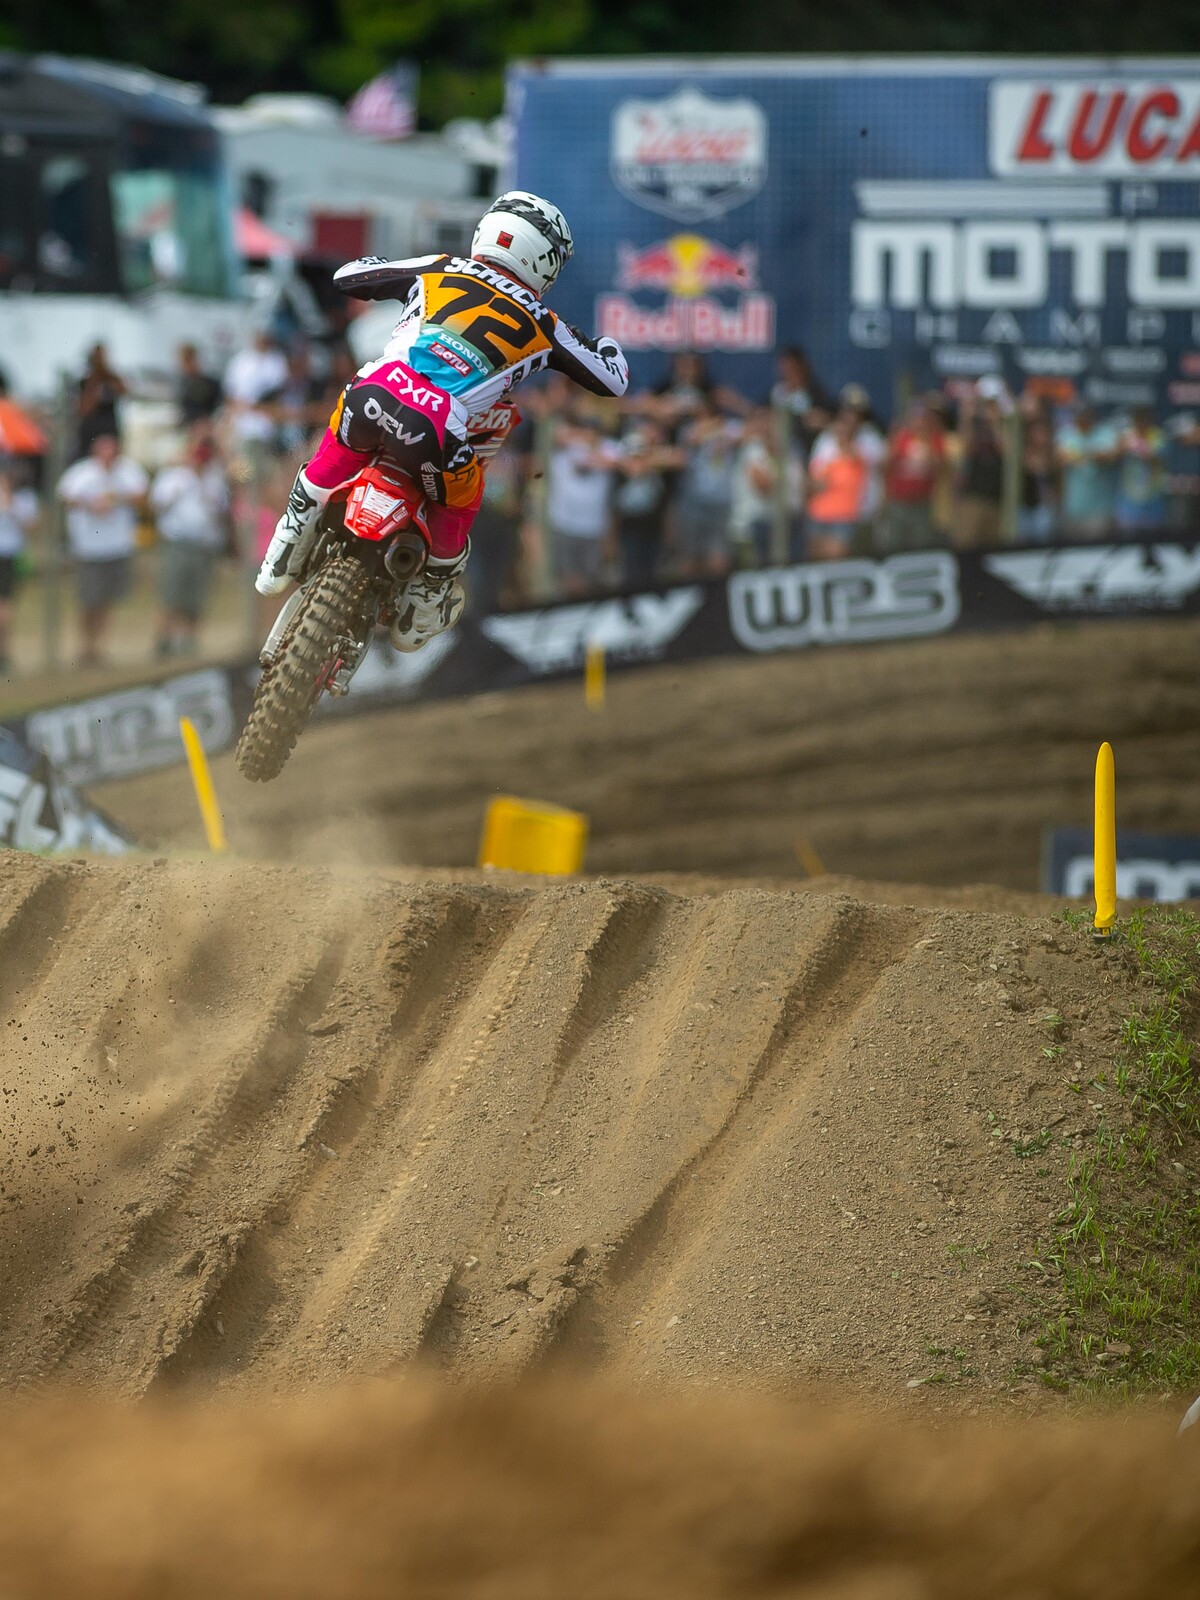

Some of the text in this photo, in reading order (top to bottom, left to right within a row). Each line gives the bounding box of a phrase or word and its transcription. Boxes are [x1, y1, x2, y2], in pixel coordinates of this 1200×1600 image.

[443, 256, 549, 321] SCHOCK
[850, 219, 1200, 308] MOTO
[426, 275, 538, 369] 72
[596, 292, 777, 352] Red Bull
[429, 344, 471, 375] MOTUL
[437, 332, 490, 376] HONDA
[385, 365, 444, 413] FXR
[467, 408, 512, 430] FXR
[421, 472, 439, 502] HON
[727, 551, 962, 653] WPS
